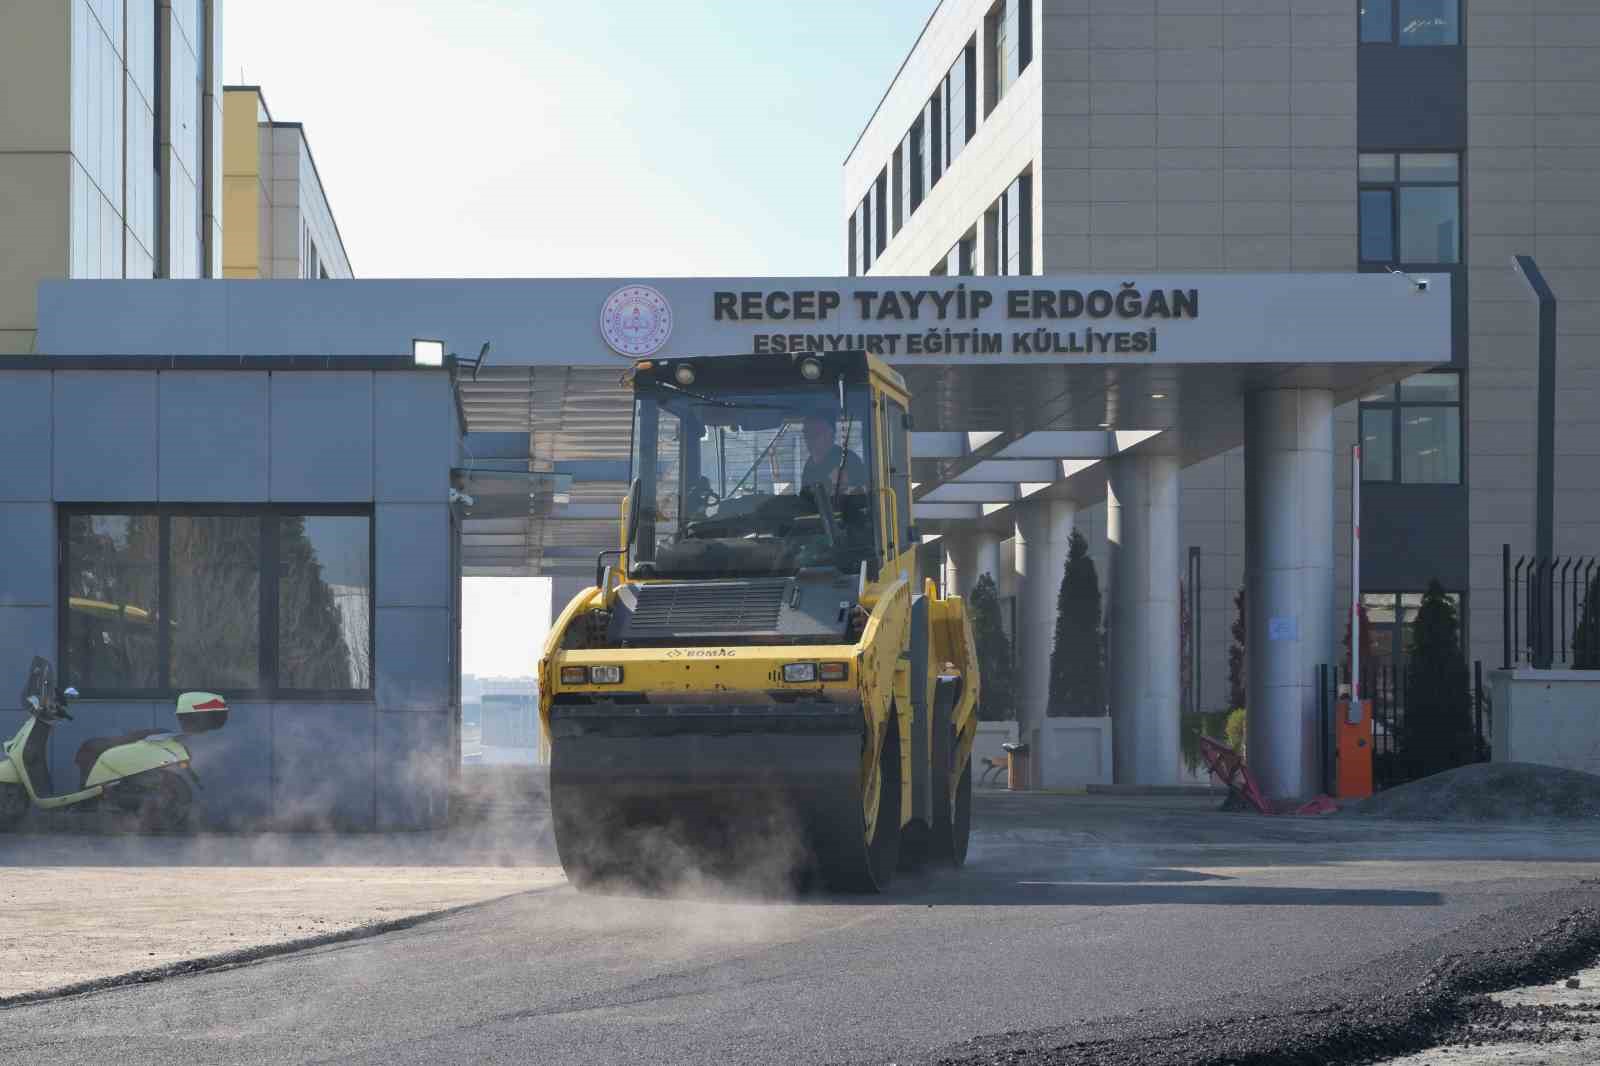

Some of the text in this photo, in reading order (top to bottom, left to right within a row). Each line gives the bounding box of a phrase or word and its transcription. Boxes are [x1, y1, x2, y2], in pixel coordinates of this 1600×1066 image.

[713, 281, 1199, 321] RECEP TAYYİP ERDOĞAN
[753, 327, 1158, 354] ESENYURT EĞİTİM KÜLLİYESİ
